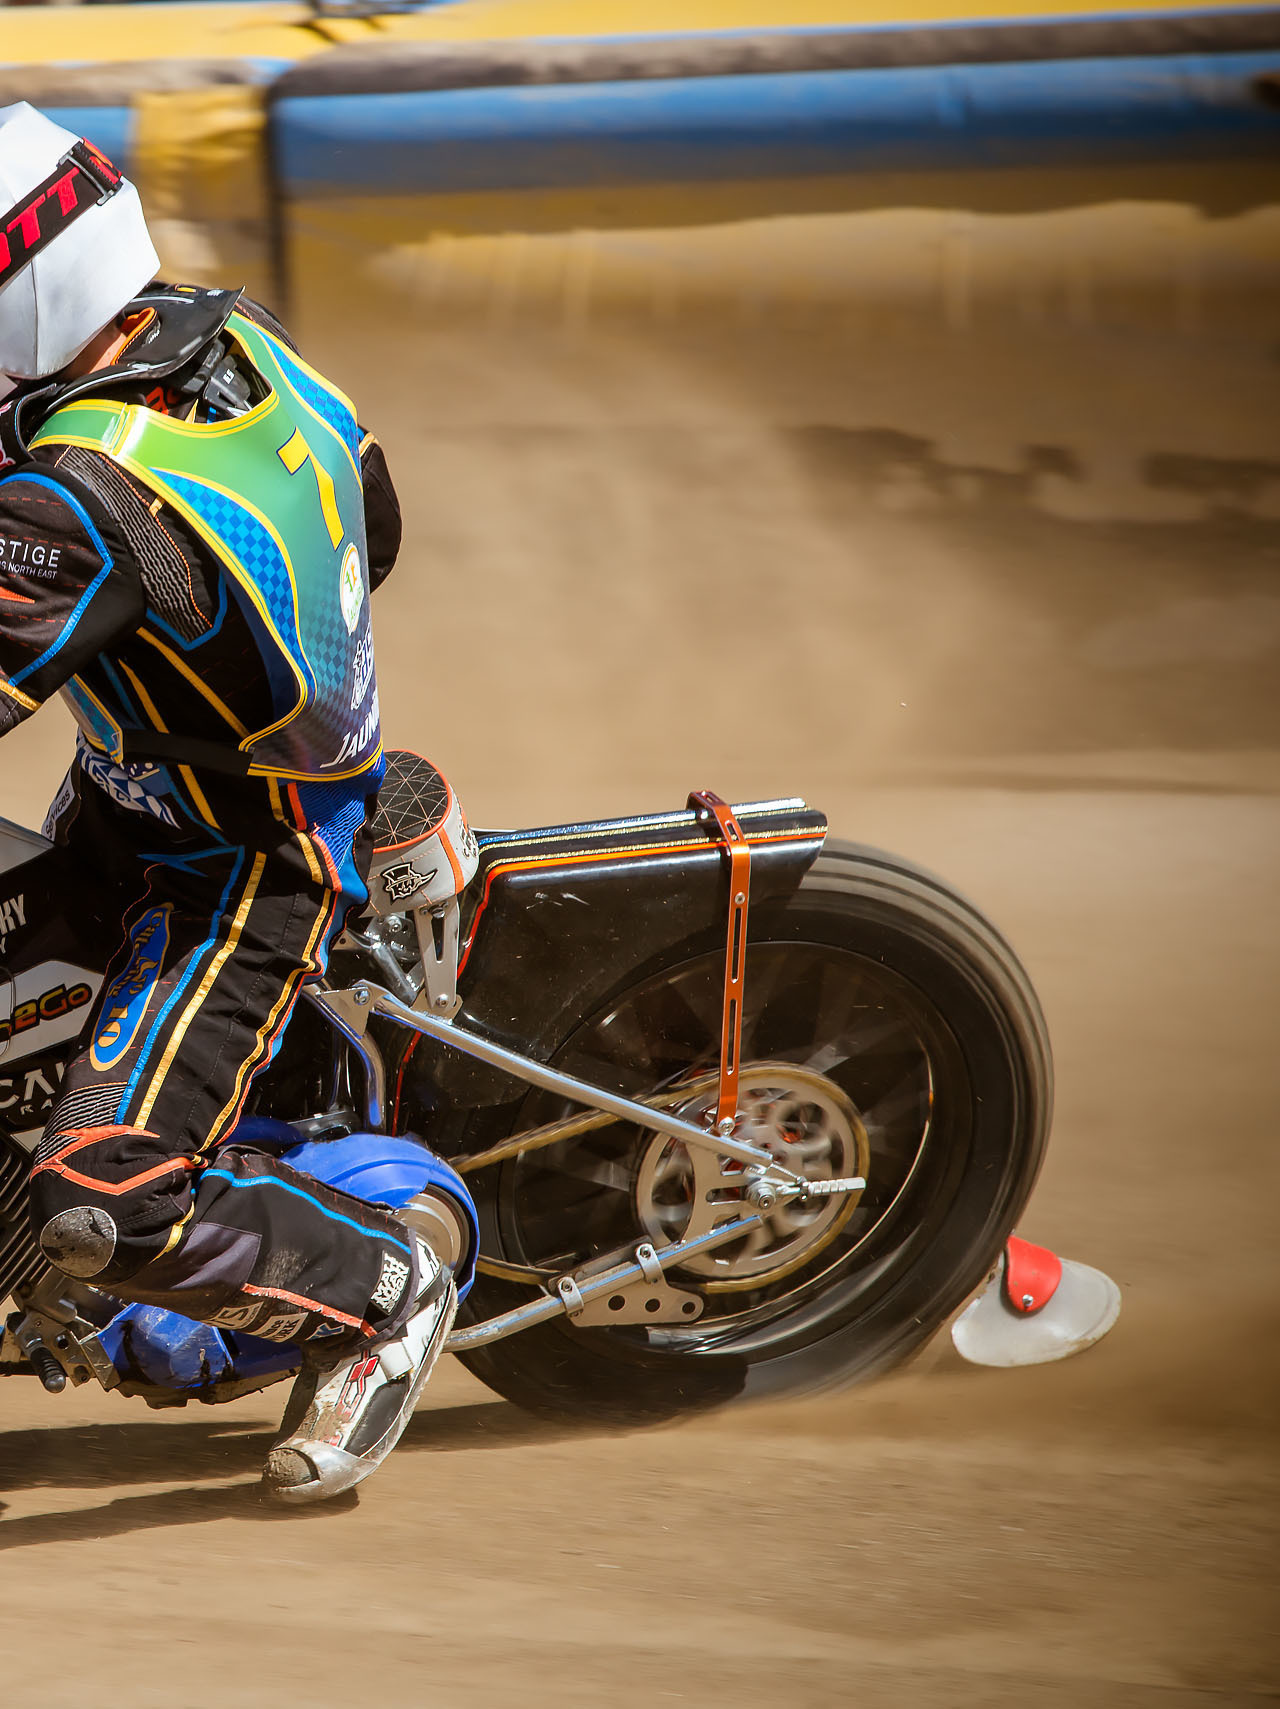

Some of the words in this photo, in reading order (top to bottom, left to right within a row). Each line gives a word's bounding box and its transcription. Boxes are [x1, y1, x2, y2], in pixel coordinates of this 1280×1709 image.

[276, 426, 345, 551] 7
[7, 561, 37, 576] NORTH
[37, 569, 58, 580] EAST
